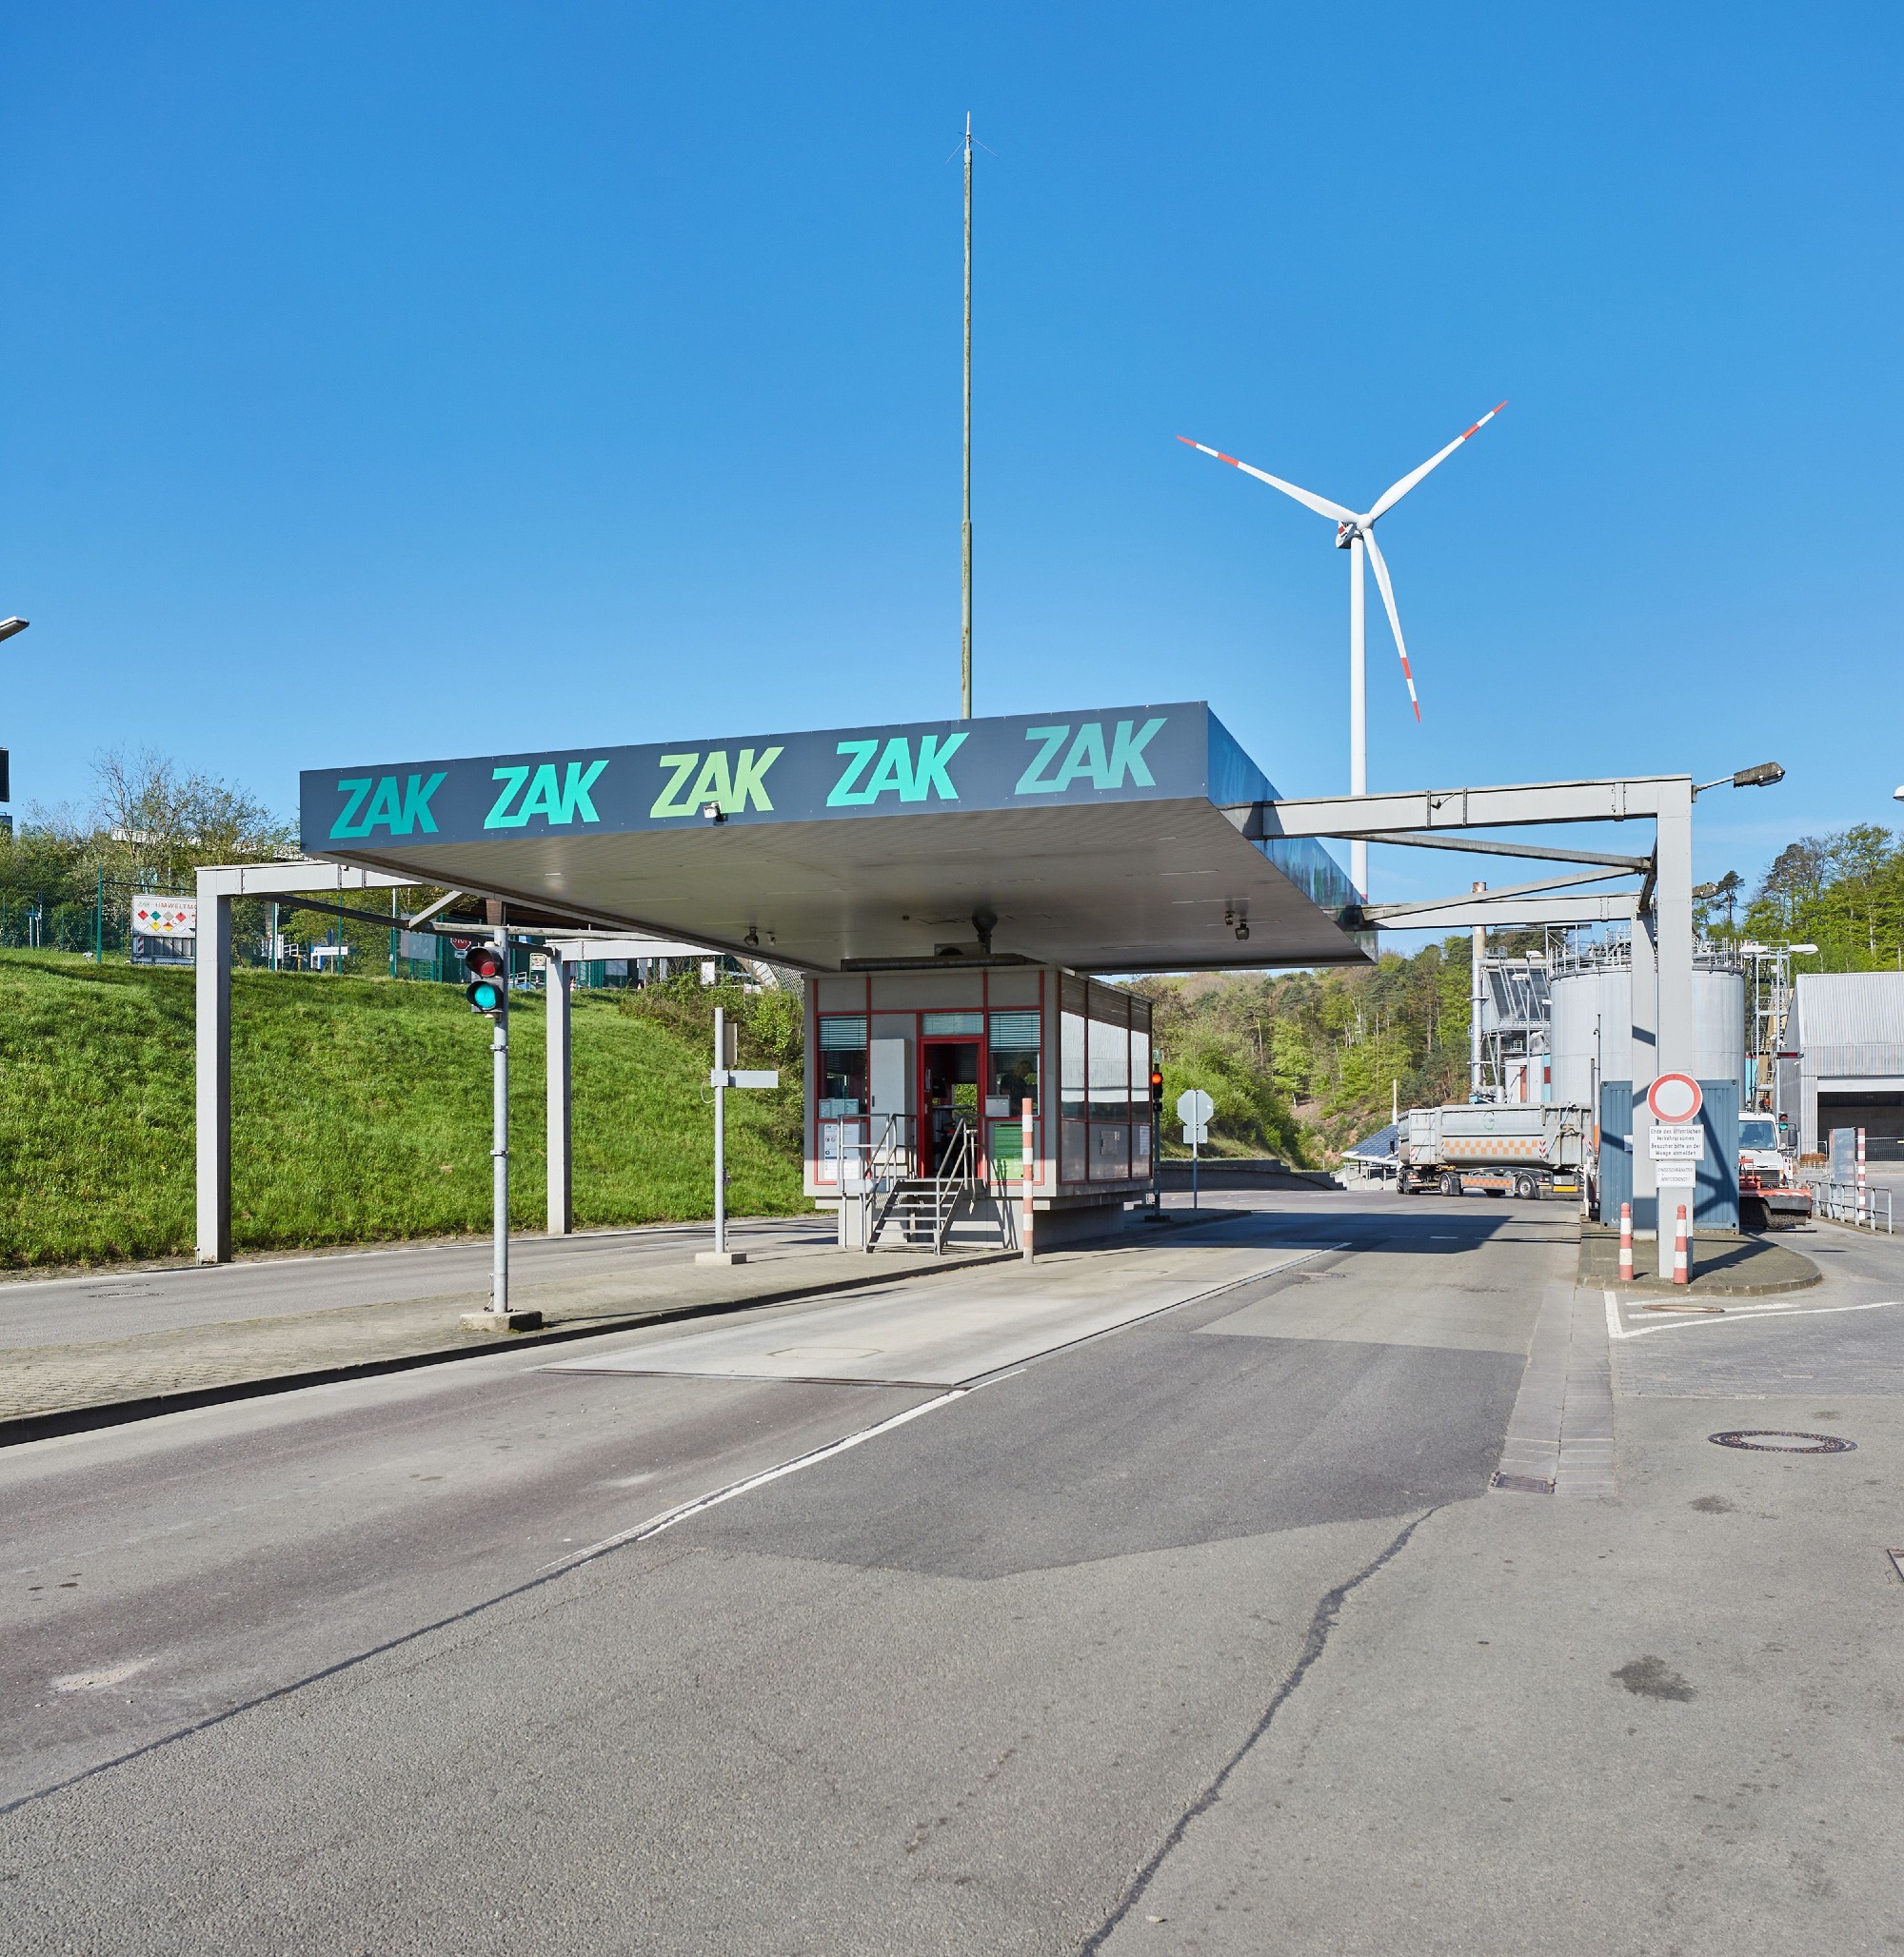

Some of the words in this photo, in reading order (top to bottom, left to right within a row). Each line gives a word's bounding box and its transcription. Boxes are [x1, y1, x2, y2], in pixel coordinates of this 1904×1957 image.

[649, 746, 785, 820] ZAK
[827, 732, 968, 807] ZAK
[1017, 718, 1166, 794] ZAK
[330, 772, 446, 839] ZAK
[484, 761, 609, 829] ZAK
